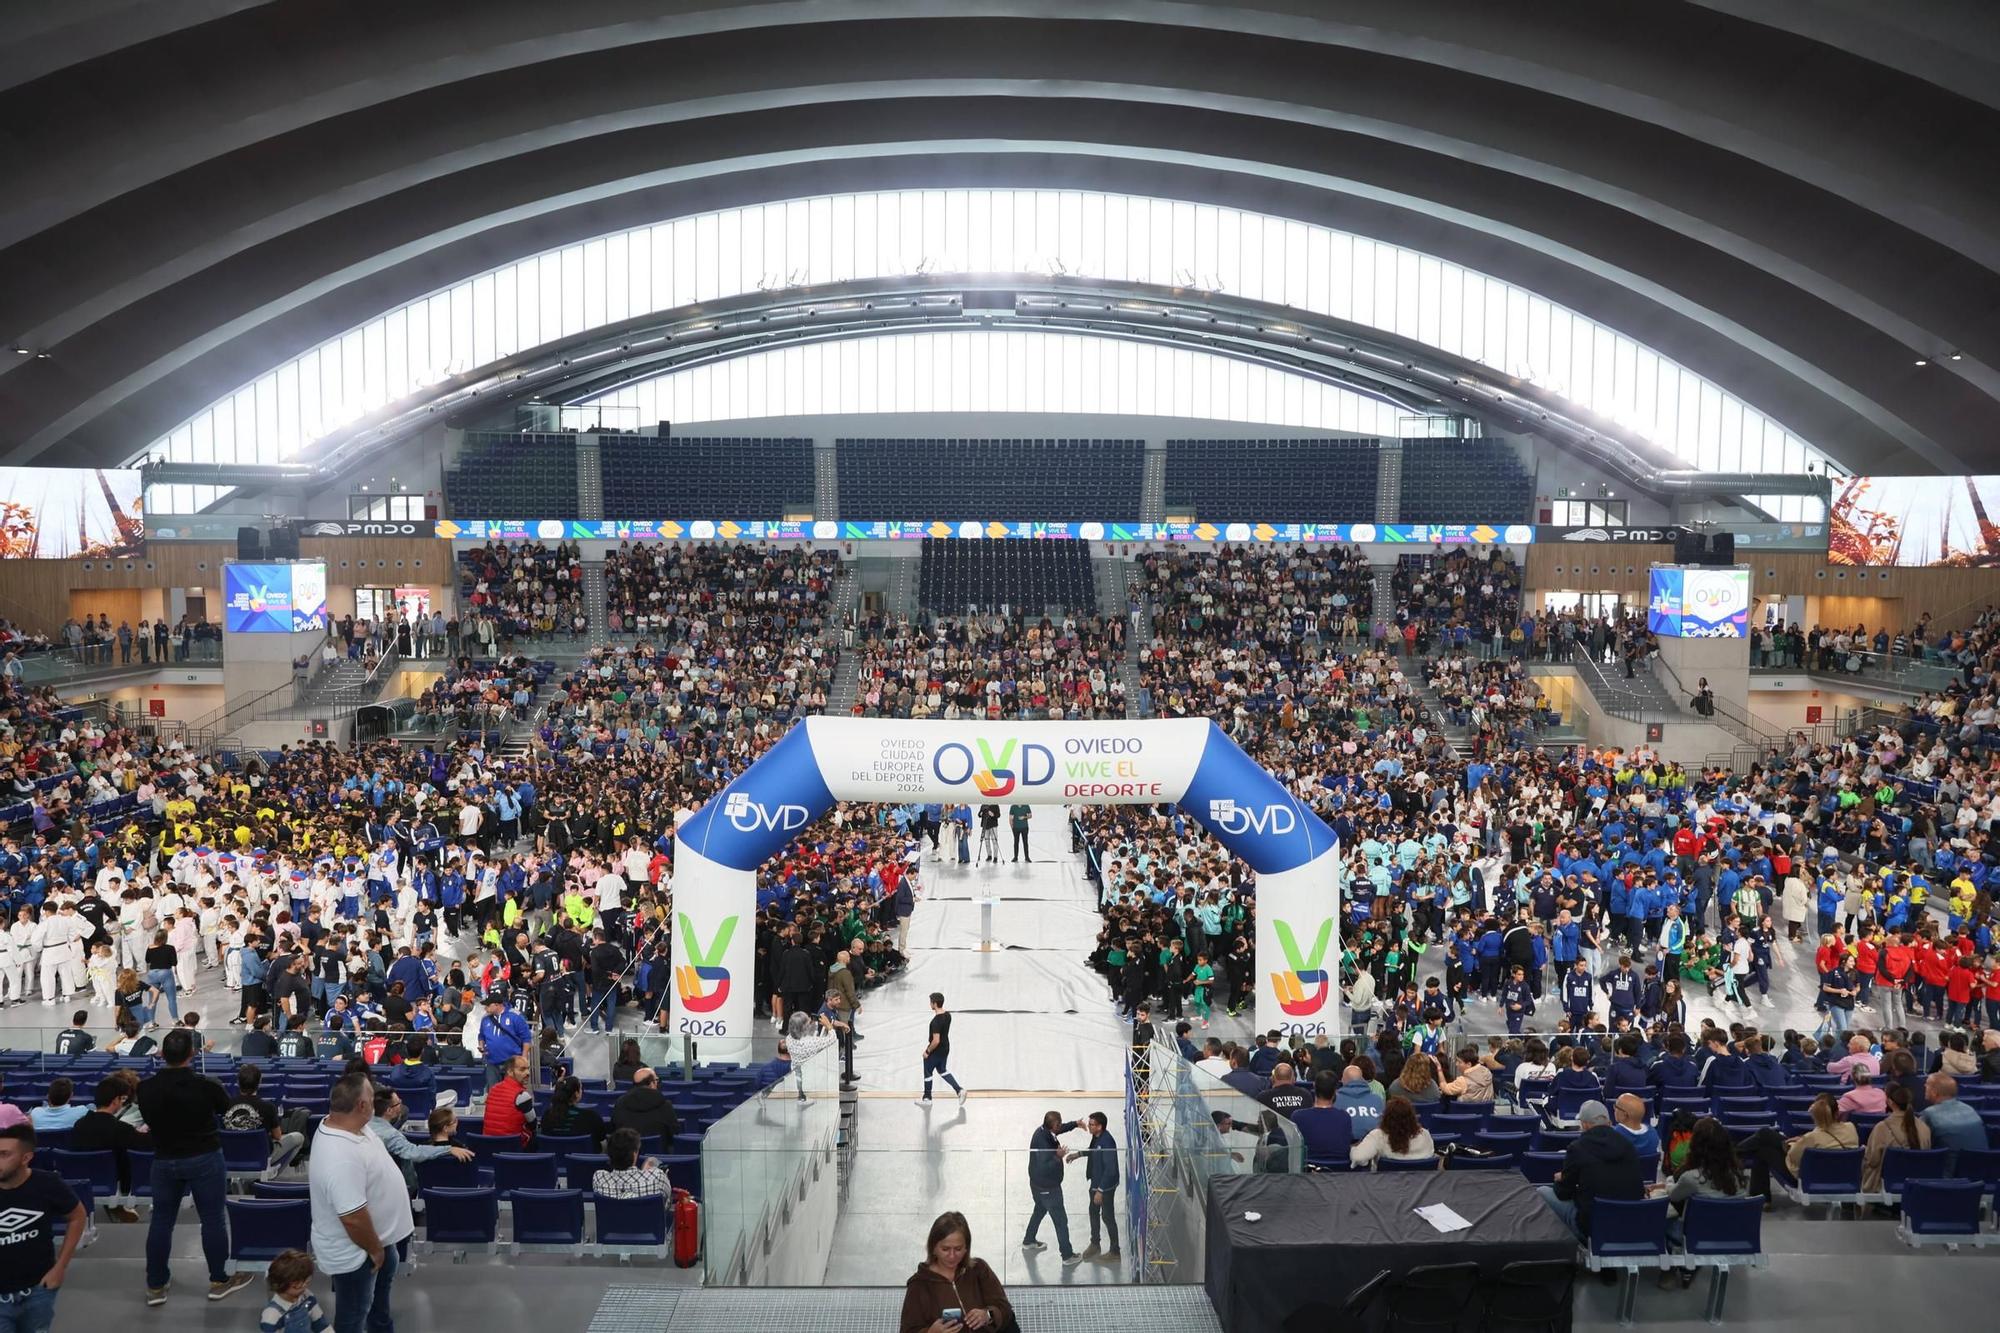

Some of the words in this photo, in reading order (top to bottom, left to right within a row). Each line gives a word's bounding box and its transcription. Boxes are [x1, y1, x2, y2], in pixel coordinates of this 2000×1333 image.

[880, 739, 925, 748] OVIEDO
[1064, 738, 1143, 754] OVIEDO
[880, 750, 925, 760] CIUDAD
[873, 761, 924, 772] EUROPEA
[932, 738, 1056, 797] OVD
[1064, 761, 1112, 778] VIVE
[1117, 762, 1139, 777] EL
[852, 772, 872, 781] DEL
[876, 773, 925, 783] DEPORTE
[897, 784, 925, 792] 2026
[1064, 783, 1162, 797] DEPORTE
[731, 801, 808, 832] OVD
[1218, 804, 1296, 835] OVD
[680, 1017, 726, 1036] 2026
[1280, 1021, 1326, 1038] 2026
[60, 1040, 70, 1054] 6
[0, 1229, 39, 1246] mbro
